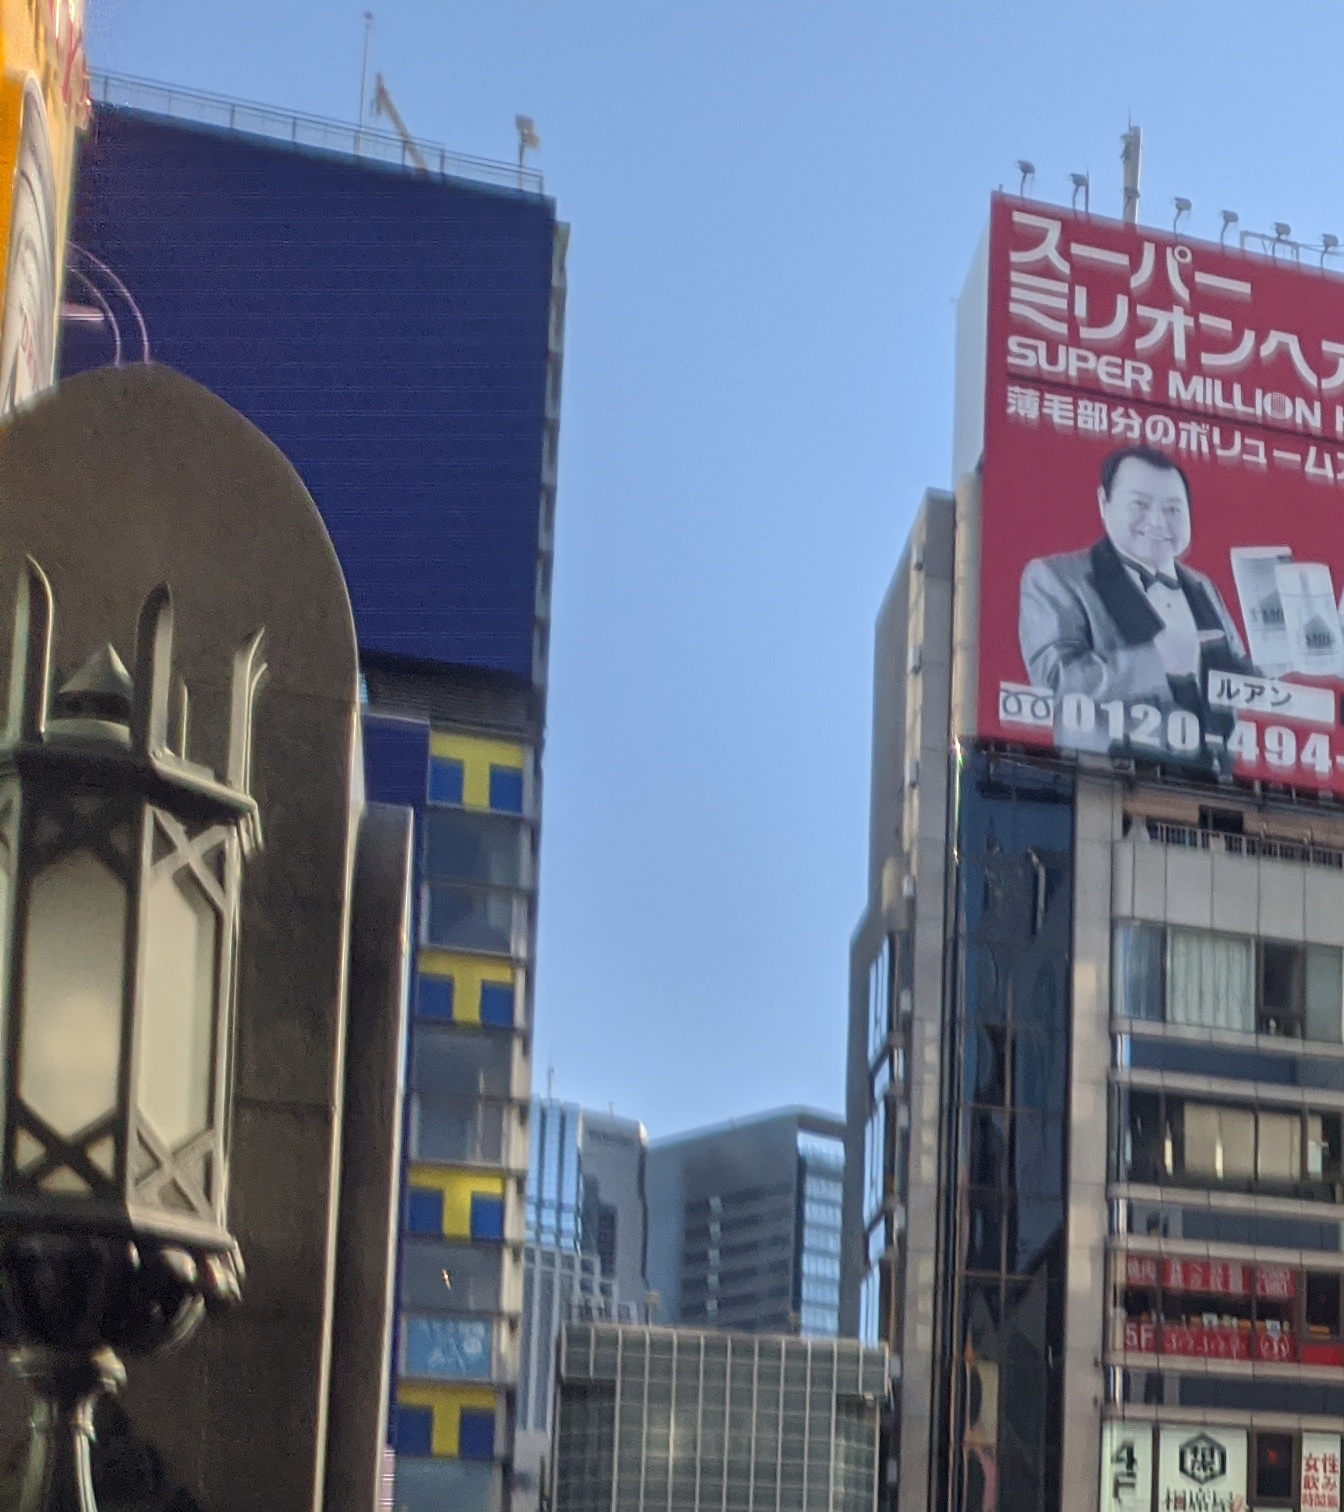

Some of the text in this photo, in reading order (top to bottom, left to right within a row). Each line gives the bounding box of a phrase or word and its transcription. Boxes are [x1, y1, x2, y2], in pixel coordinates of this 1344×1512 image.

[1010, 209, 1252, 301] スーパー
[1007, 334, 1153, 393] SUPER
[1168, 367, 1322, 430] MILLION
[1215, 677, 1293, 708] ルアン
[1125, 1322, 1155, 1351] 5F
[1110, 1438, 1140, 1505] 4F
